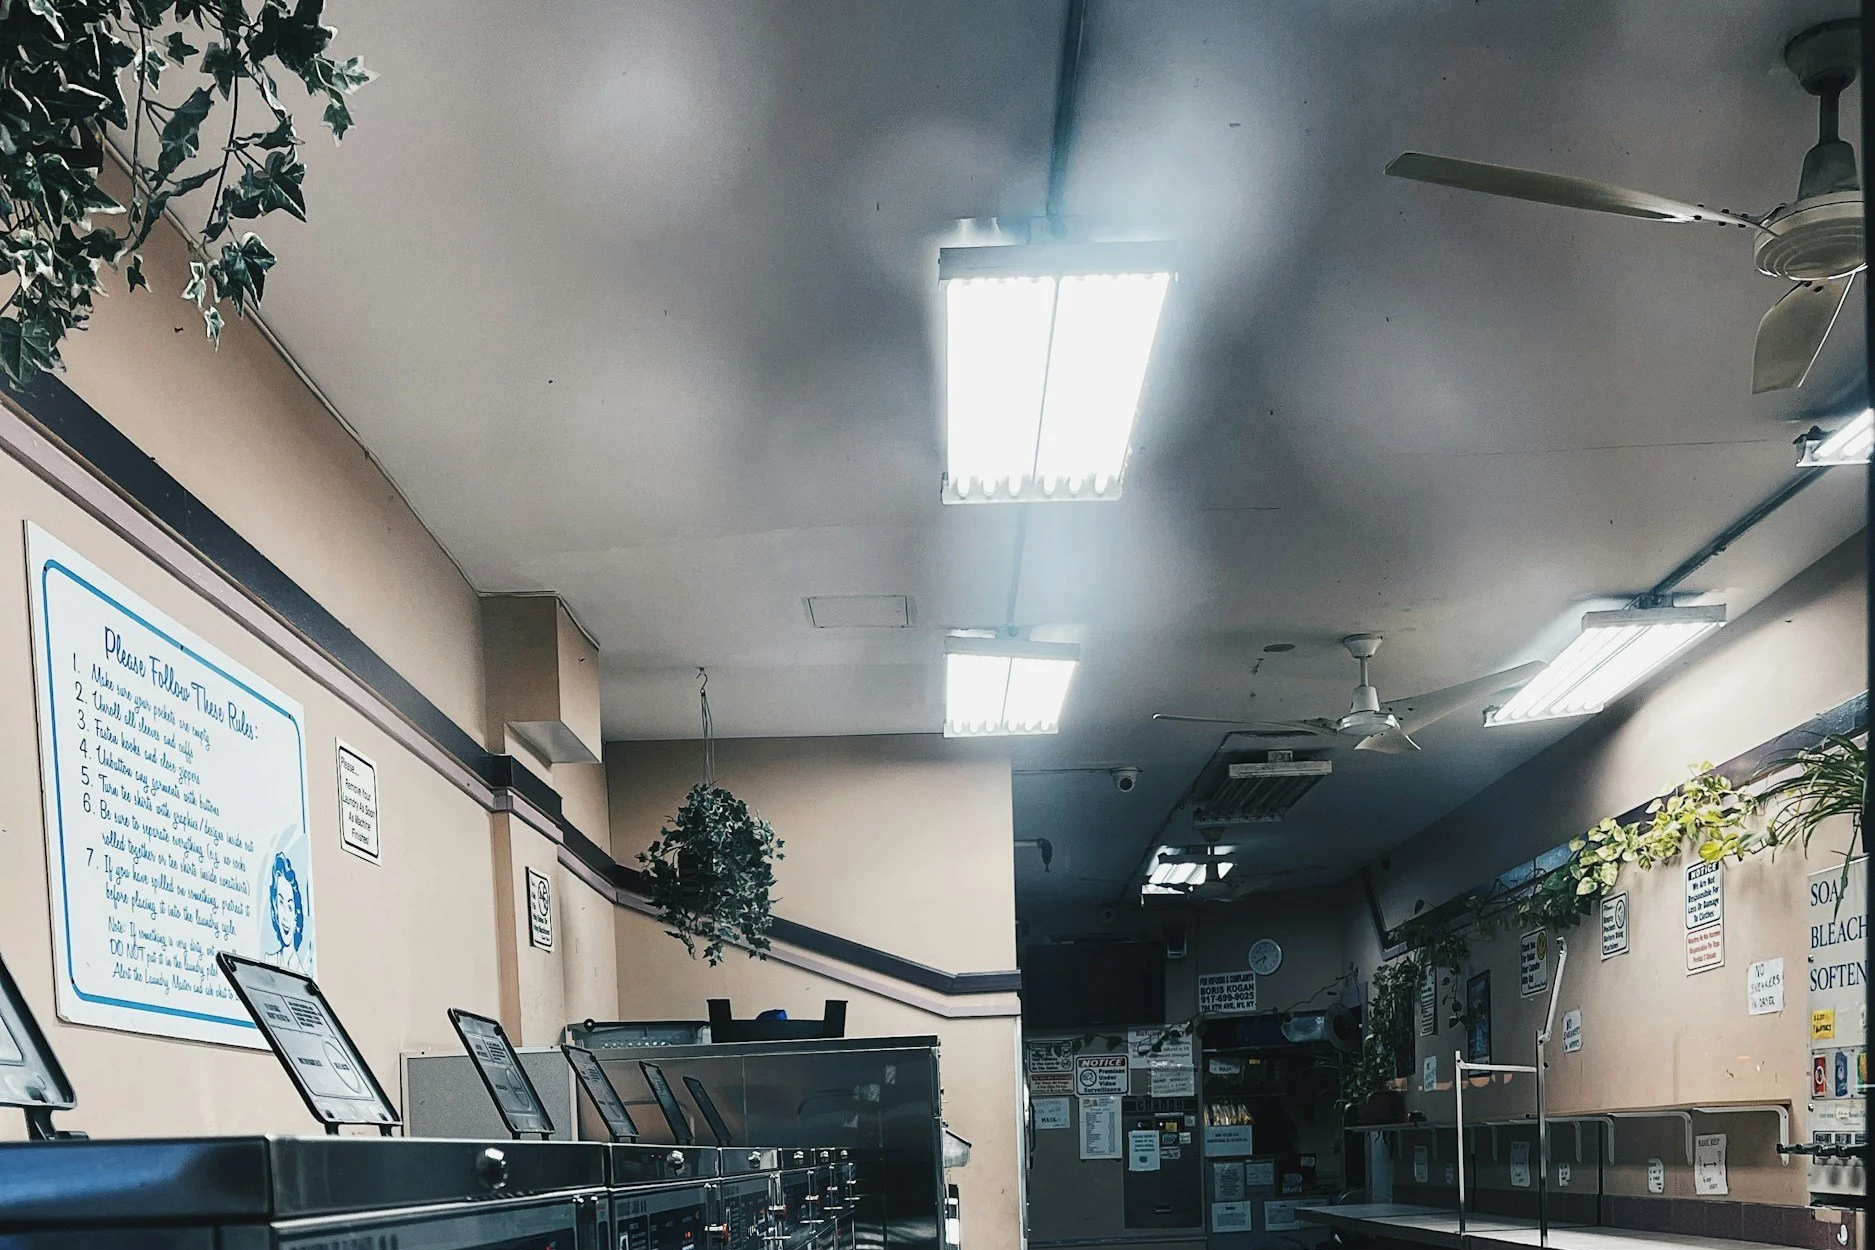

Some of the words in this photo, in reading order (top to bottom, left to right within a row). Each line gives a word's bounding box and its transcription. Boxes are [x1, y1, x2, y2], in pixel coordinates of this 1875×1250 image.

[73, 652, 81, 674] 1.
[91, 663, 114, 692] Make
[116, 684, 132, 702] sure
[134, 695, 151, 714] your
[105, 625, 146, 677] Please
[149, 655, 190, 702] Follow
[190, 681, 225, 723] These
[227, 701, 258, 741] Rules:
[75, 681, 88, 705] 2.
[92, 690, 121, 721] Unroll
[124, 709, 136, 729] all
[163, 731, 176, 749] and
[77, 709, 89, 732] 3.
[94, 718, 118, 746] Fasten
[121, 731, 141, 757] hooks
[145, 747, 157, 764] and
[79, 738, 92, 760] 4.
[96, 745, 132, 778] Unbutton
[81, 765, 94, 787] 5.
[98, 773, 118, 798] Turn
[83, 792, 96, 814] 6.
[100, 799, 112, 820] Be
[114, 813, 130, 829] sure
[131, 815, 140, 831] to
[104, 854, 113, 882] If
[1690, 862, 1717, 880] NOTICE
[105, 881, 129, 910] before
[1810, 878, 1846, 907] SOA
[1810, 913, 1869, 949] BLEACH
[110, 938, 124, 957] DO
[126, 942, 146, 961] NOT
[1200, 985, 1225, 996] BORIS
[1226, 983, 1255, 993] KOGAN
[1081, 1058, 1123, 1067] NOTICE
